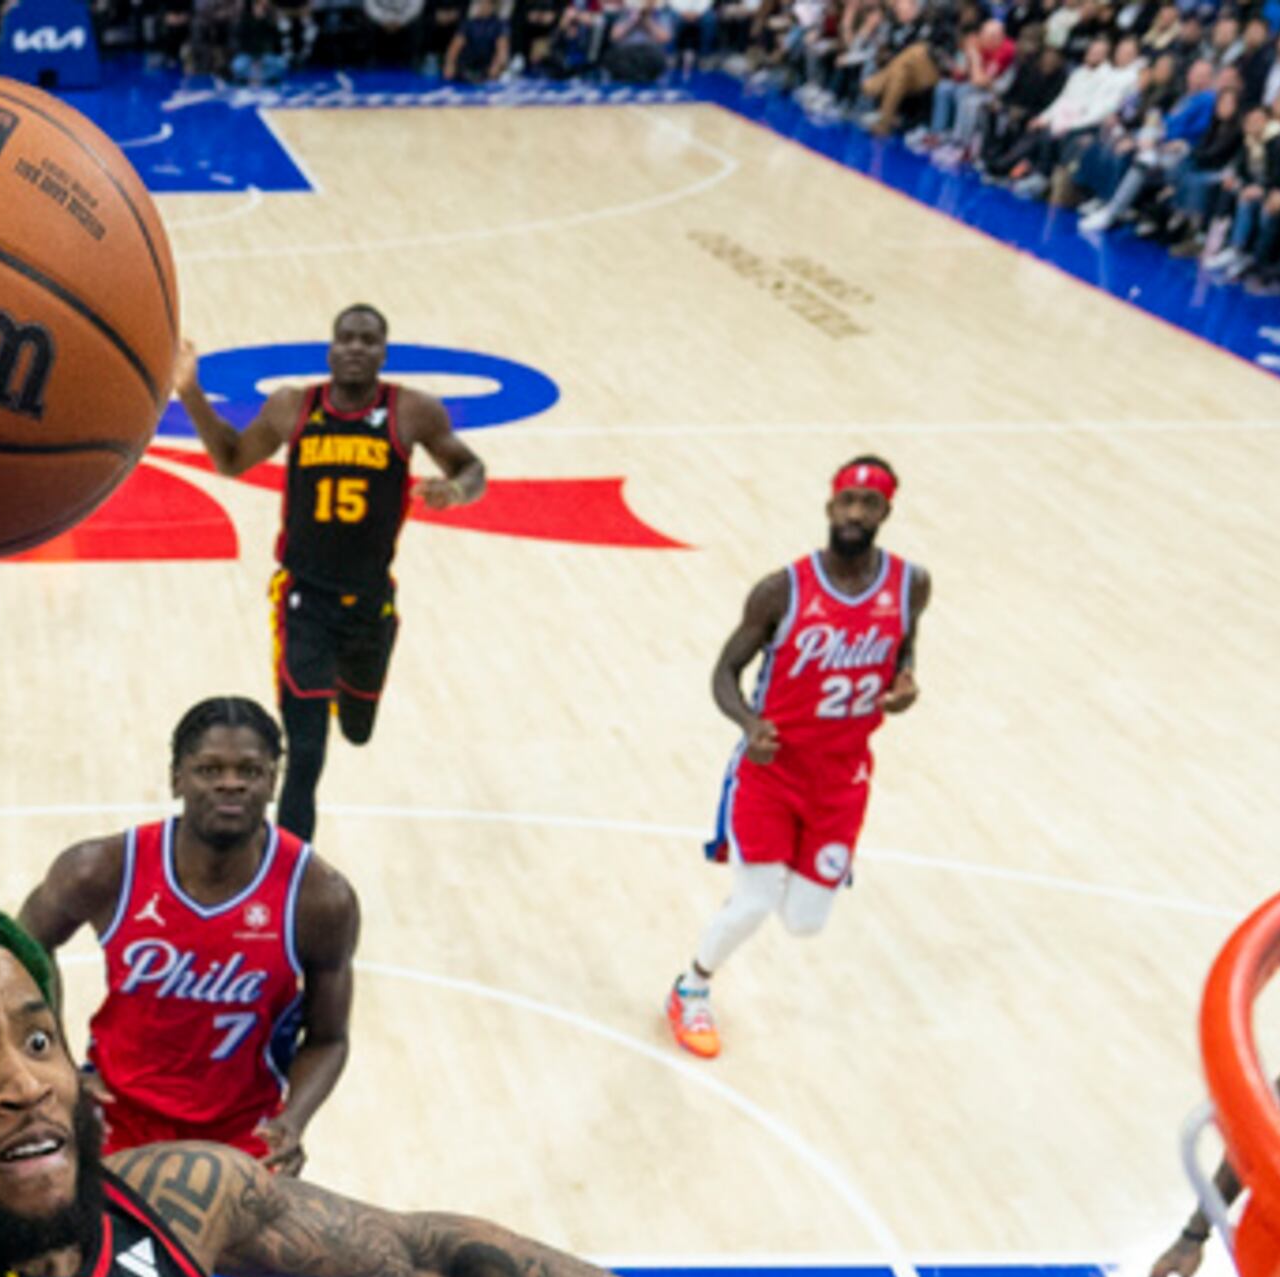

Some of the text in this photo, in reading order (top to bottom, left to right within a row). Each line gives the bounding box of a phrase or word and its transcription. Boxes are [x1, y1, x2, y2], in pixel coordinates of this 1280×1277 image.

[299, 434, 390, 470] HAWKS
[314, 476, 370, 524] 15
[787, 622, 895, 679] Phila
[814, 672, 884, 719] 22
[121, 937, 269, 1004] Phila
[209, 1011, 257, 1061] 7
